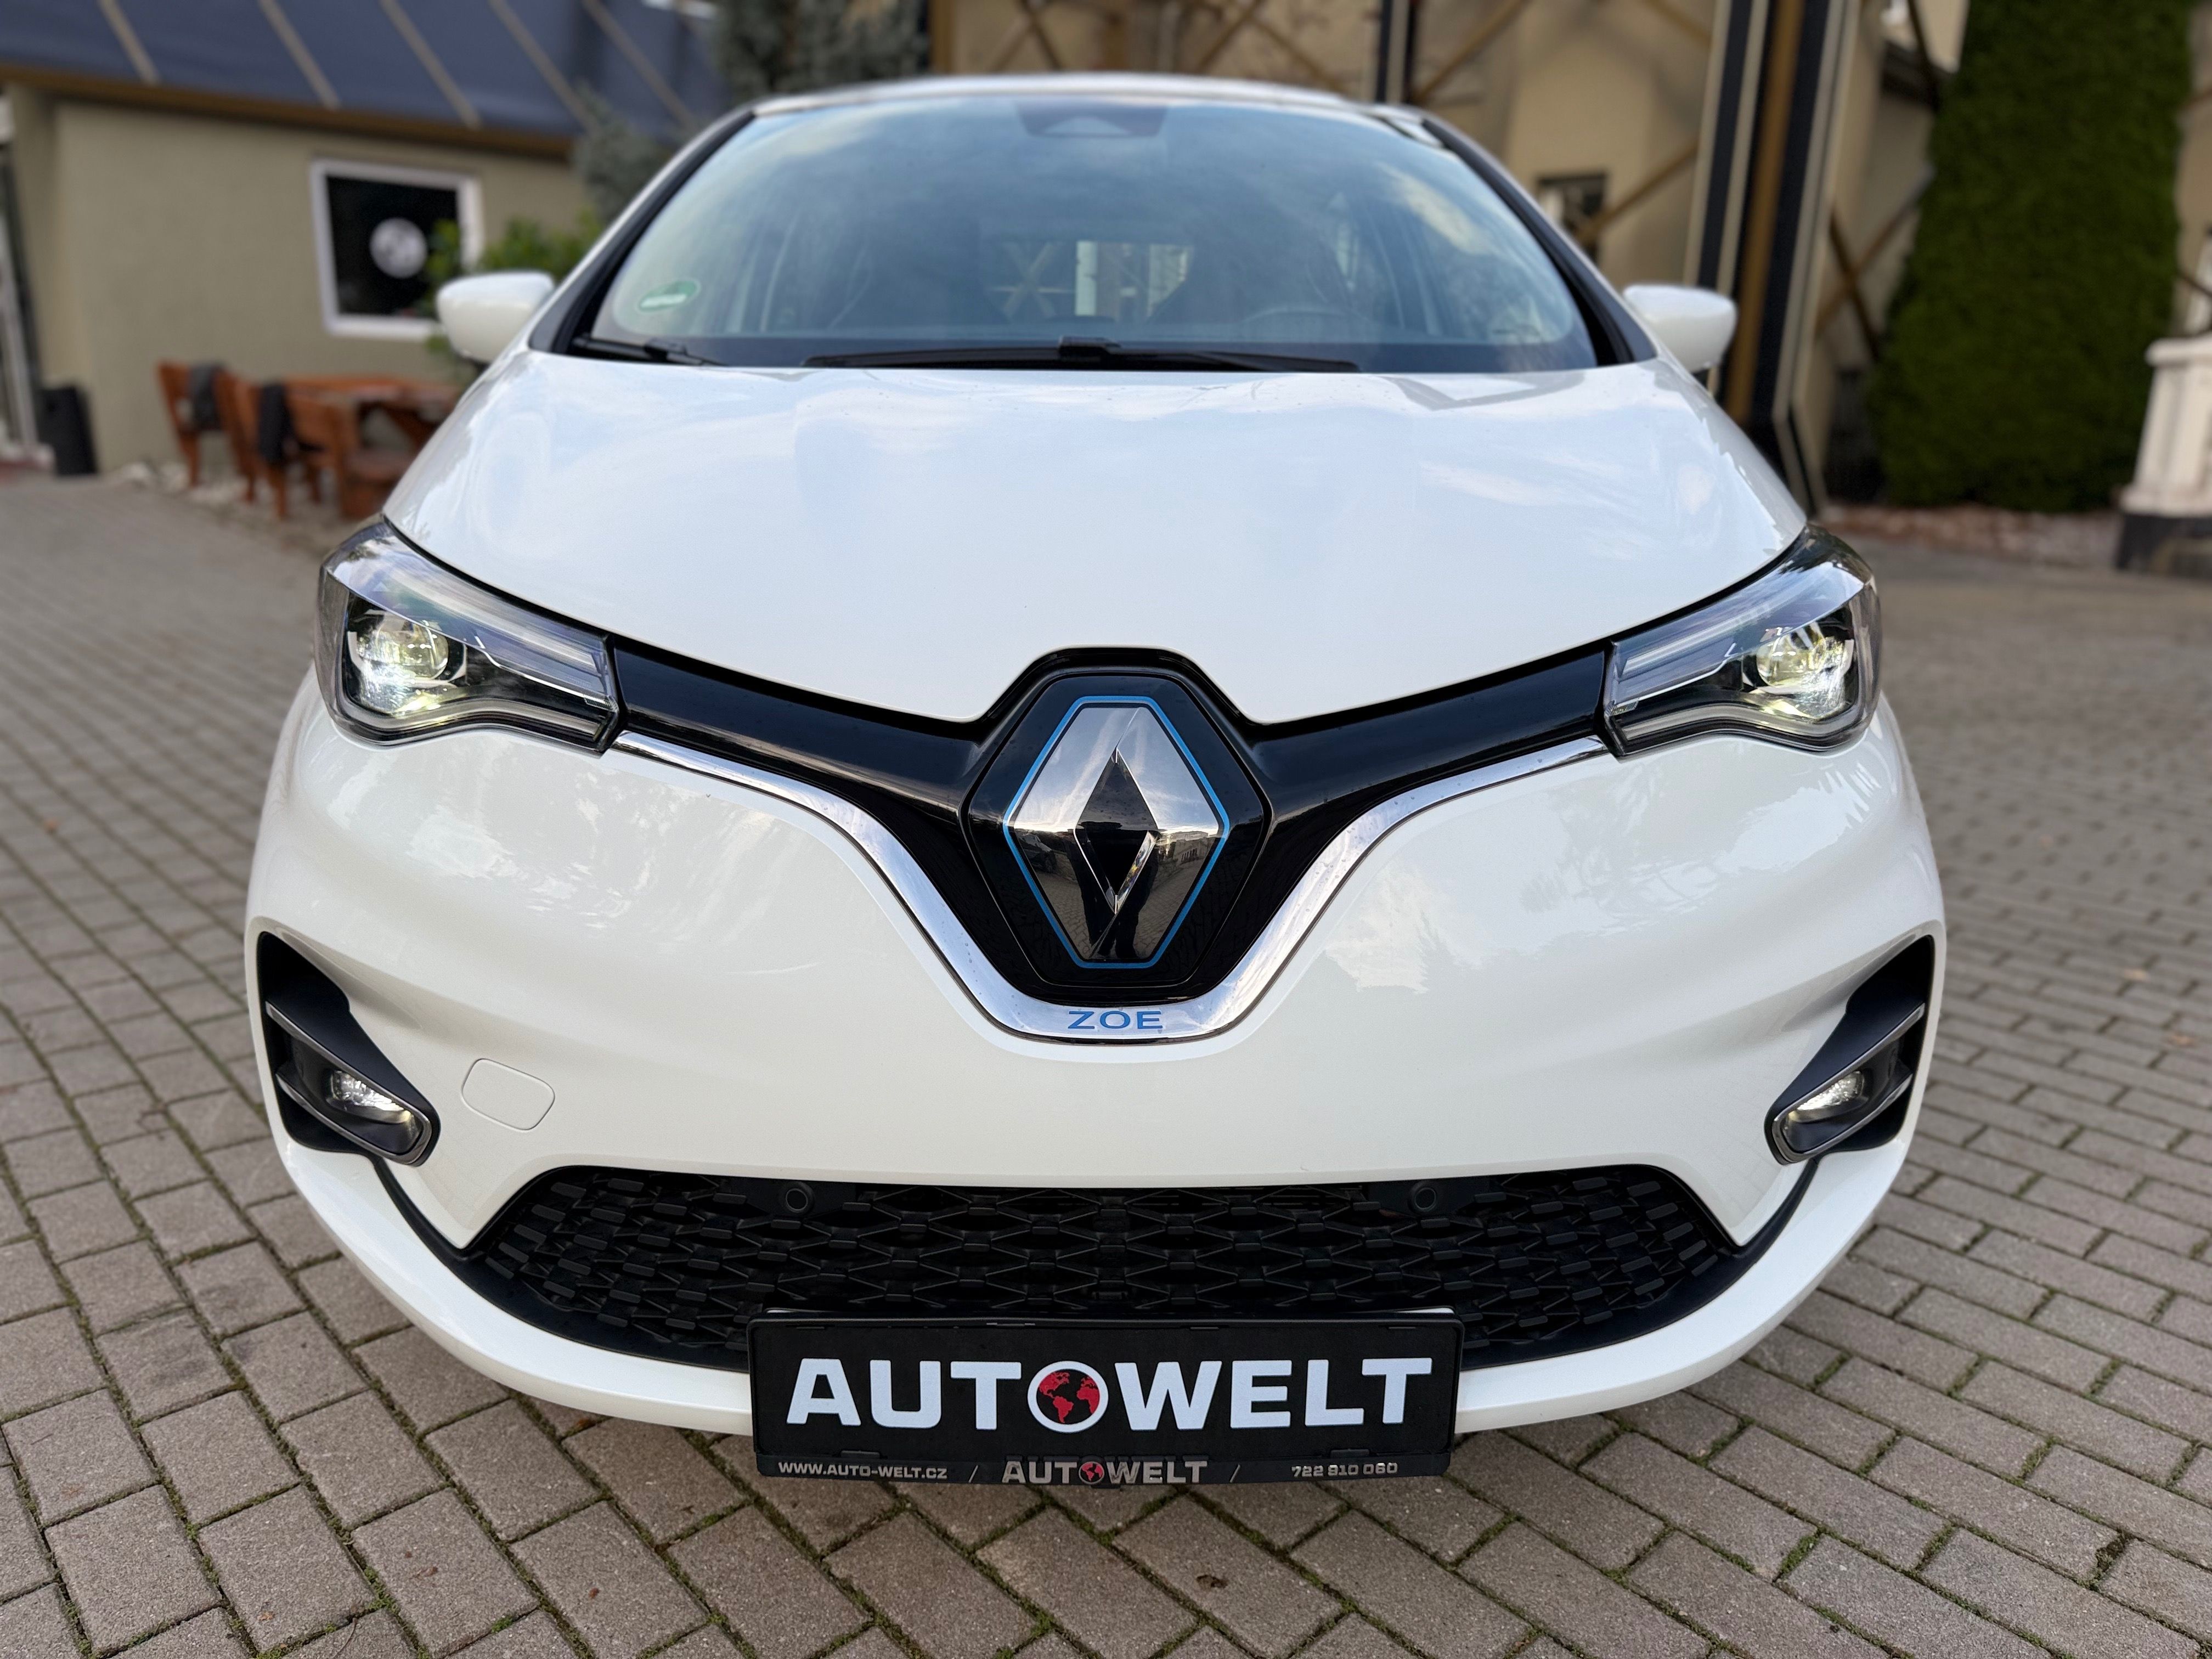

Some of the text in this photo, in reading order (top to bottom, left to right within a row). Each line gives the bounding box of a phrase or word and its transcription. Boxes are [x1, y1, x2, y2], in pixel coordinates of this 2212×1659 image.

[1068, 1010, 1163, 1029] ZOE
[786, 1358, 1433, 1433] AUTOWELT
[778, 1462, 947, 1479] WWW.AUTO-WELT.CZ
[1001, 1459, 1208, 1485] AUTOWELT
[1328, 1464, 1359, 1476] 910
[1363, 1462, 1398, 1475] 060
